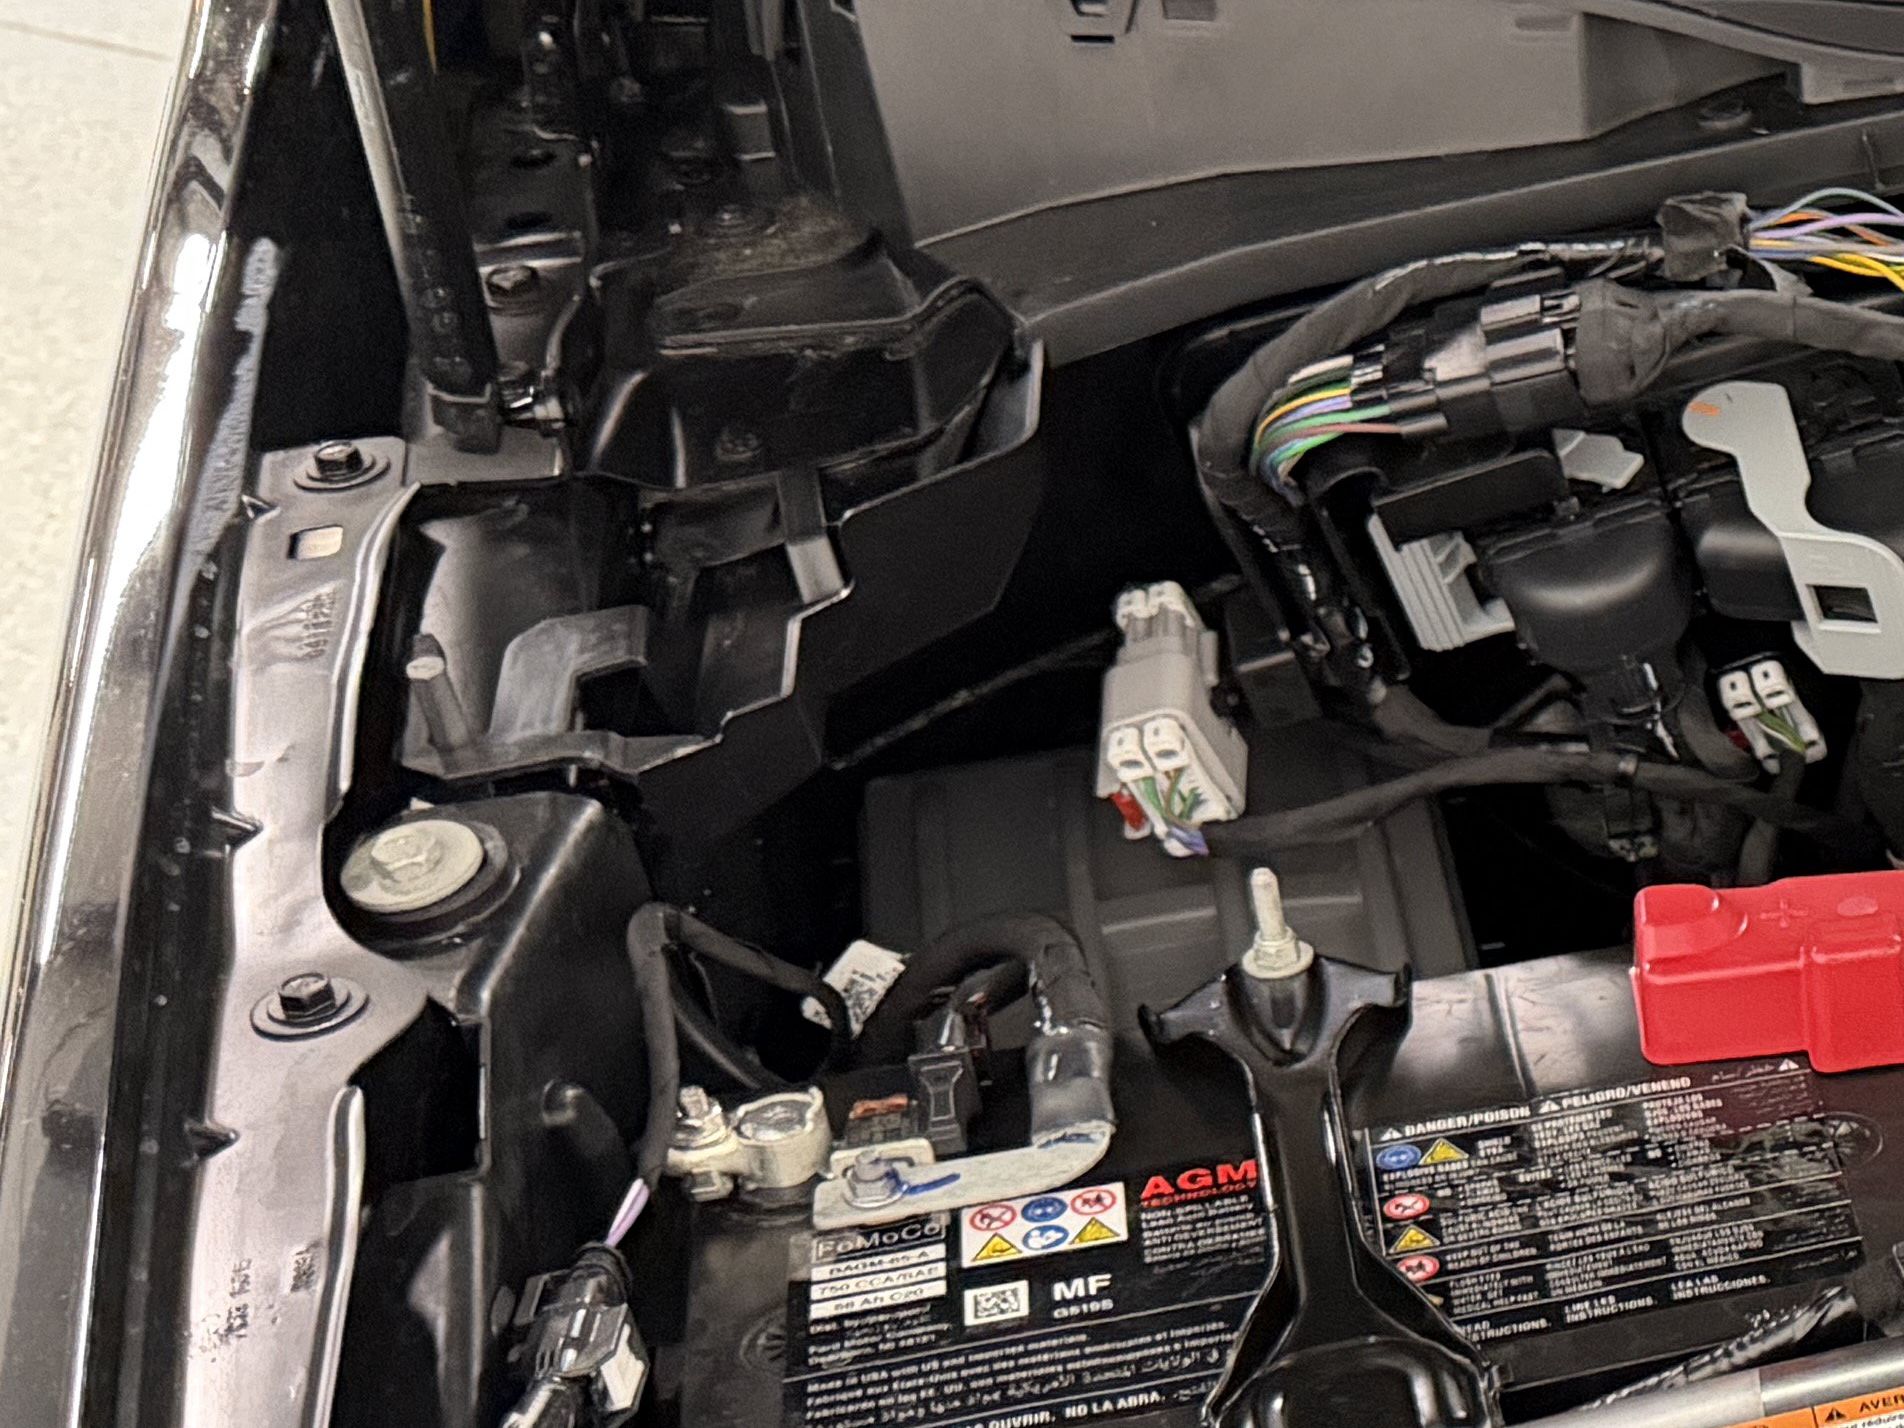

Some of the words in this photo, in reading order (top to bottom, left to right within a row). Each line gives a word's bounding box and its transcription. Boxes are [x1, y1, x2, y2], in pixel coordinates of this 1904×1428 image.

[1403, 1104, 1531, 1136] DANGER/POISON
[1139, 1158, 1257, 1199] AGM
[1053, 1272, 1111, 1301] MF
[1465, 1317, 1552, 1343] STRUCTIONS.
